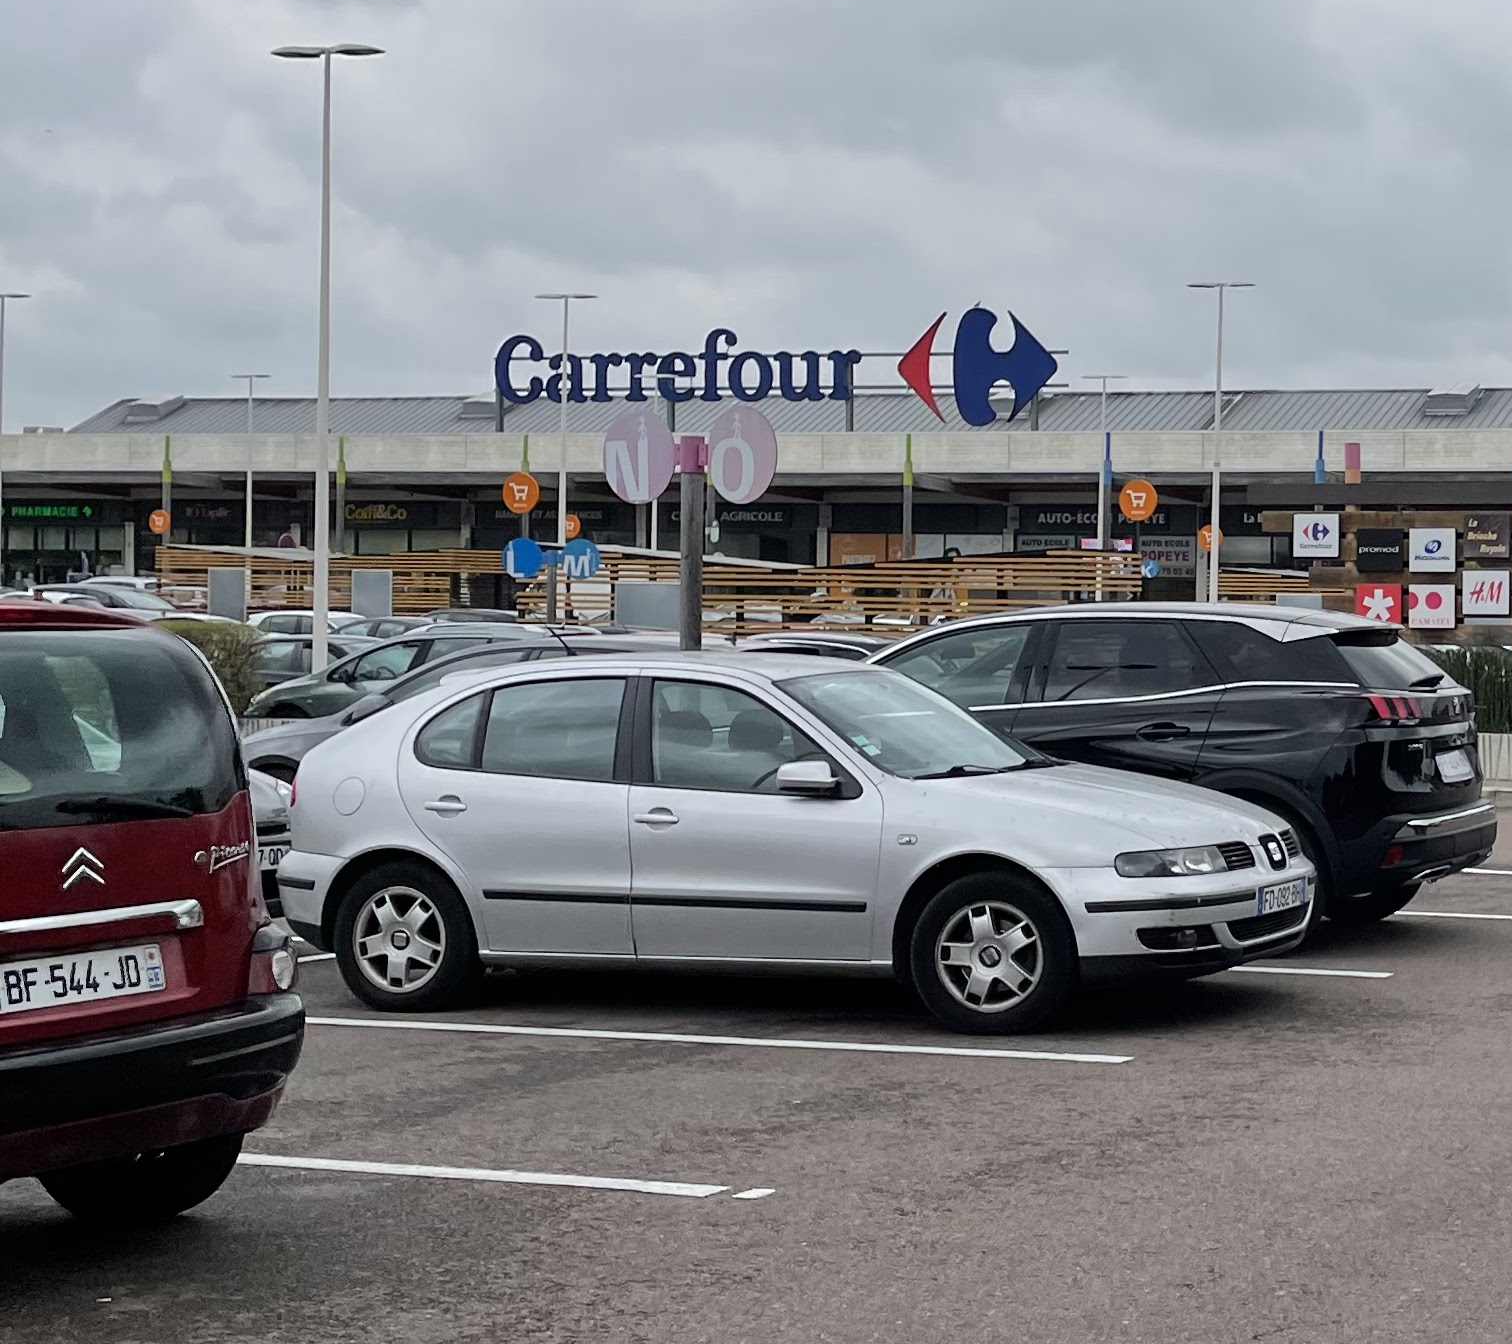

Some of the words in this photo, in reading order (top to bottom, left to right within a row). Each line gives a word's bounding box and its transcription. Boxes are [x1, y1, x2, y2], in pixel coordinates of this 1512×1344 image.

[495, 328, 862, 403] Carrefour
[605, 439, 649, 500] N
[11, 505, 79, 517] PHARMACIE
[720, 511, 784, 522] AGRICOLE
[1021, 539, 1043, 547] AUTO
[1141, 539, 1162, 548] AUTO
[1164, 539, 1190, 548] ECOLE
[1358, 545, 1400, 554] promod
[1141, 550, 1190, 562] POPEYE
[1469, 580, 1503, 605] H&M
[4, 954, 141, 1005] BF-544-JD
